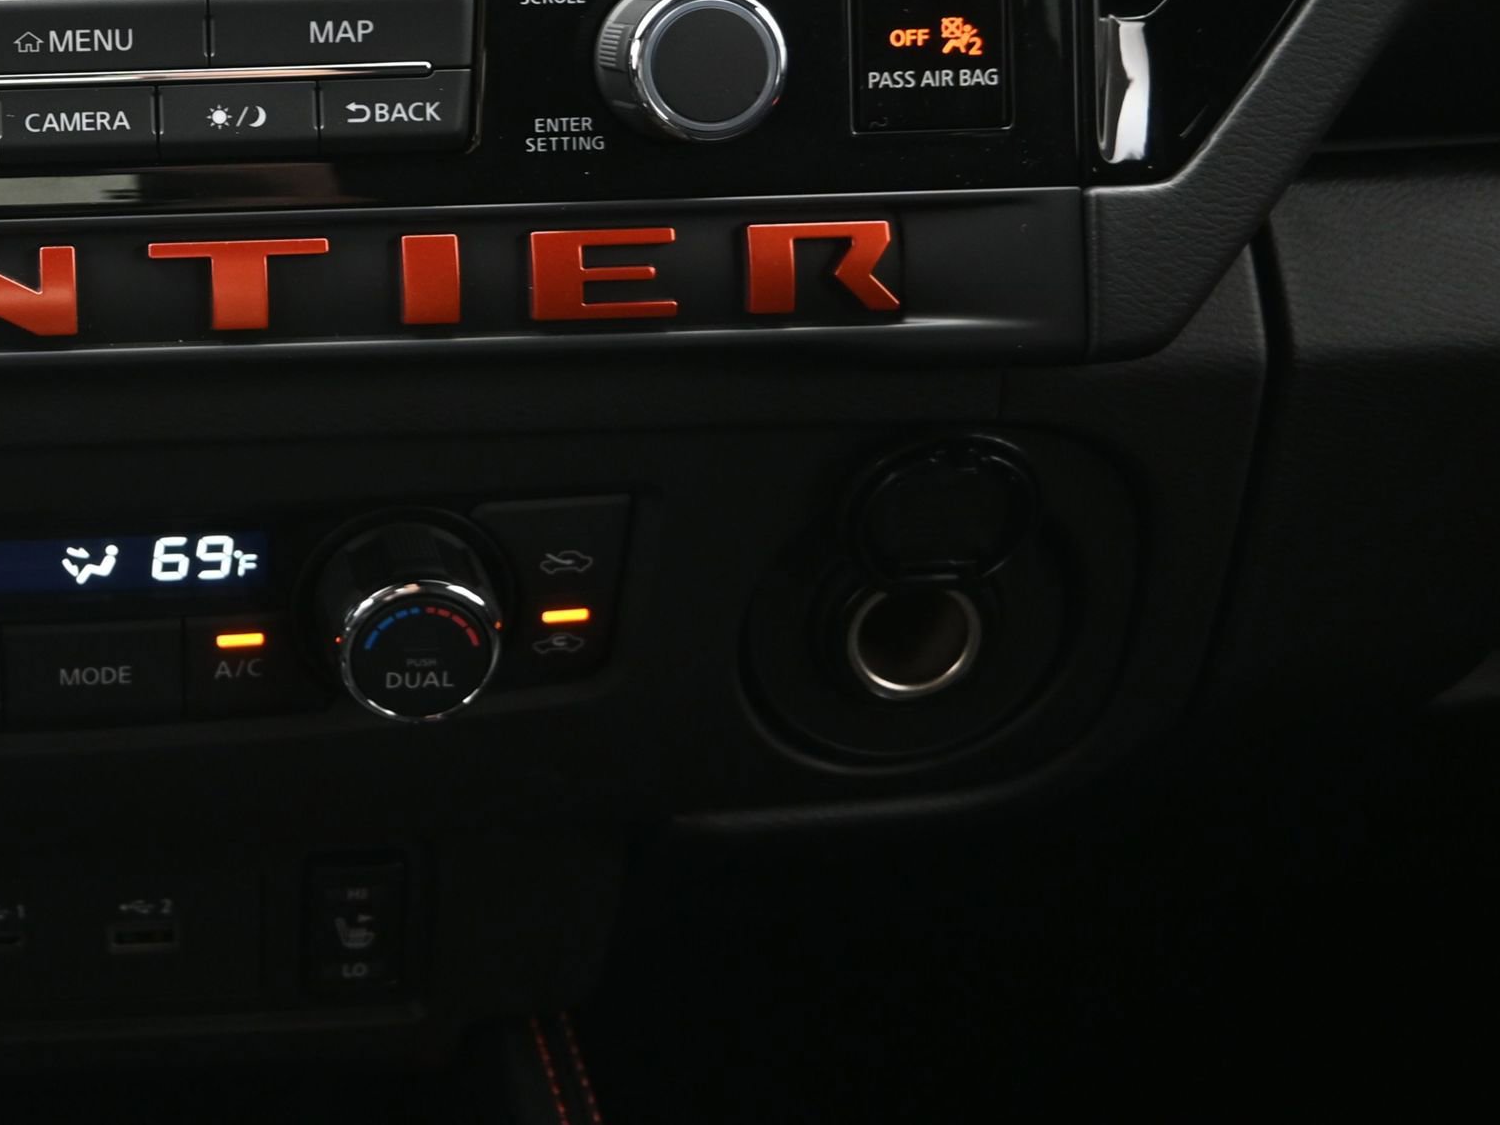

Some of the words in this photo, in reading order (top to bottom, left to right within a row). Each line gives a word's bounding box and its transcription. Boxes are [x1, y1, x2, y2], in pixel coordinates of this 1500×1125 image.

[49, 28, 133, 53] MENU
[309, 19, 374, 44] MAP
[889, 28, 931, 48] OFF
[868, 70, 916, 89] PASS
[920, 69, 954, 88] AIR
[959, 67, 999, 87] BAG
[24, 110, 131, 133] CAMERA
[374, 101, 441, 123] BACK
[534, 116, 593, 133] ENTER
[525, 135, 605, 153] SETTING
[214, 654, 261, 679] A/C
[406, 657, 437, 668] PUSH
[59, 665, 131, 686] MODE
[385, 671, 455, 689] DUAL
[342, 963, 367, 978] LO
